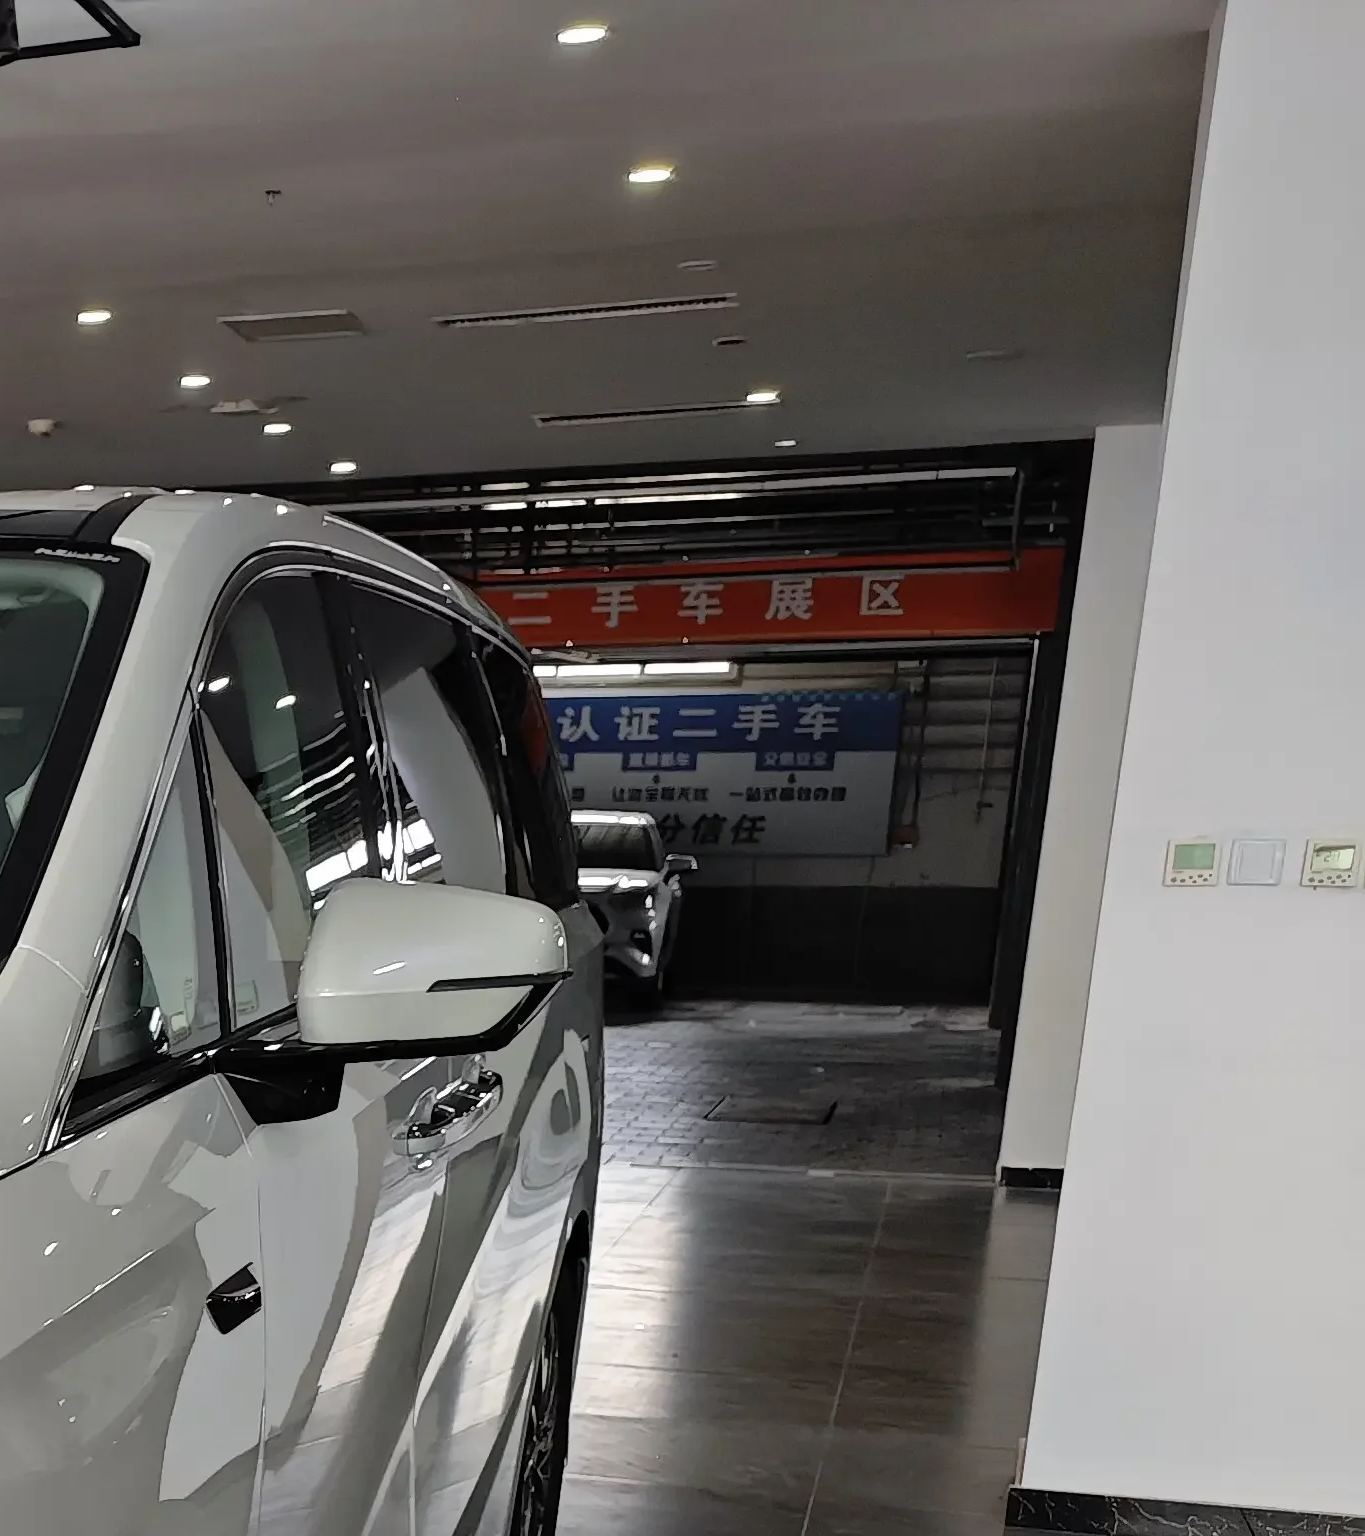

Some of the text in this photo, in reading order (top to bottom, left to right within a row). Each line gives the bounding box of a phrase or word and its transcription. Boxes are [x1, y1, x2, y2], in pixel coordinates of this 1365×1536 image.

[508, 576, 904, 628] 二手车展区
[556, 702, 841, 741] 认证二手车
